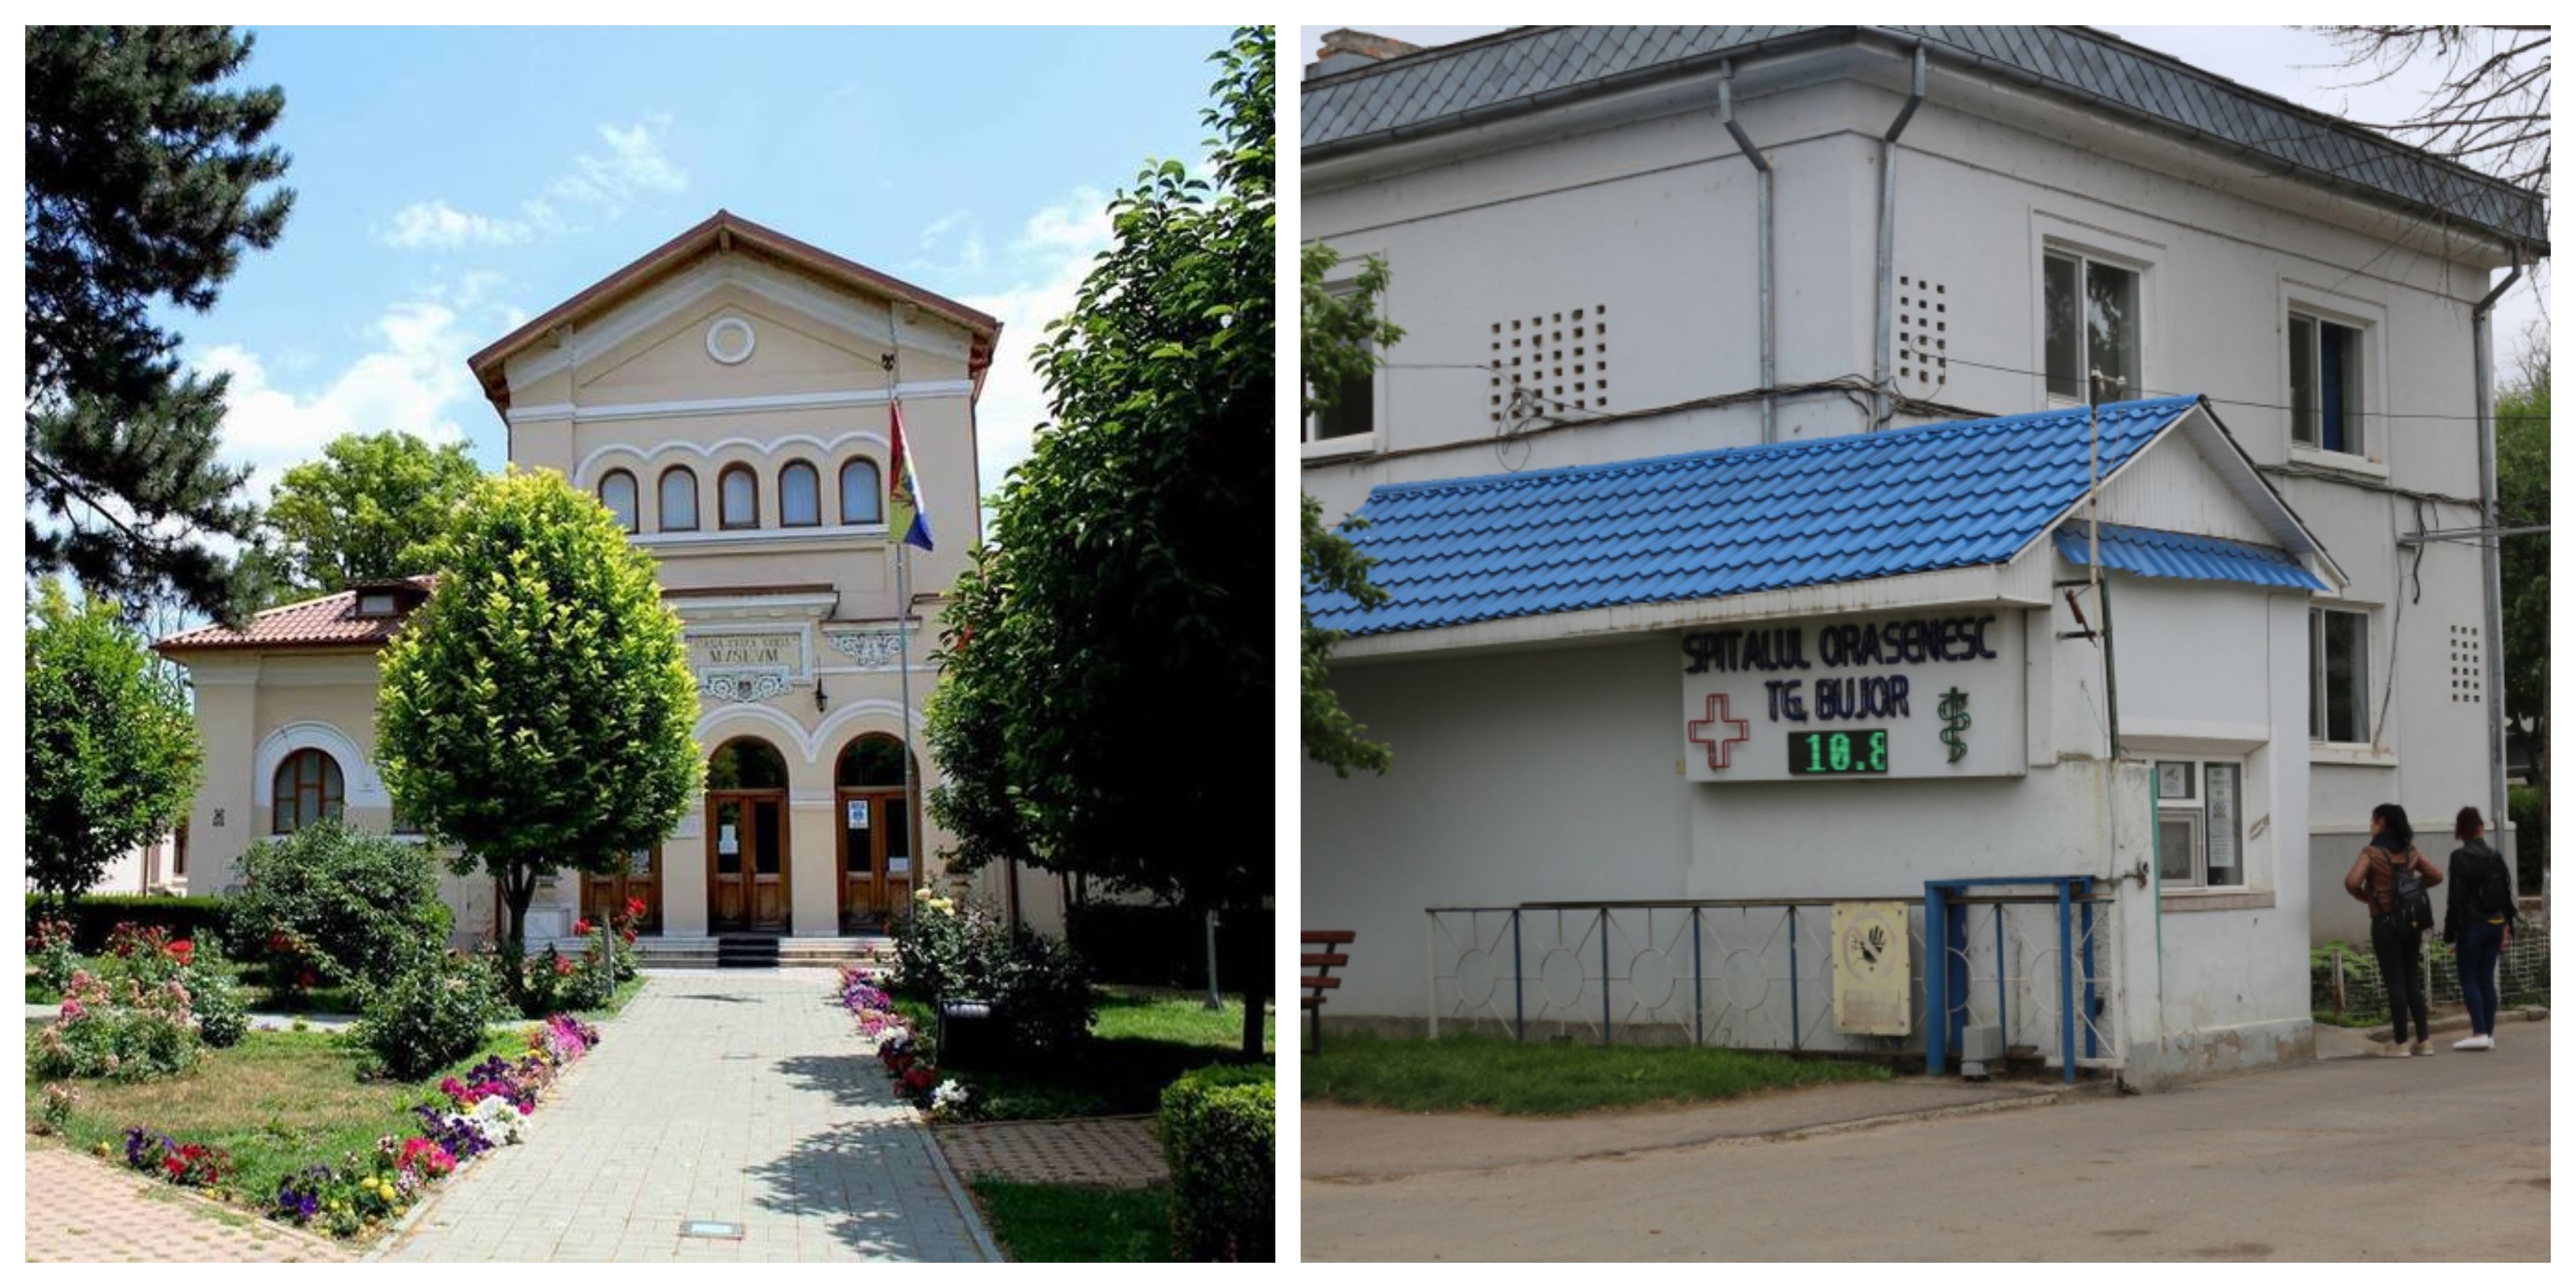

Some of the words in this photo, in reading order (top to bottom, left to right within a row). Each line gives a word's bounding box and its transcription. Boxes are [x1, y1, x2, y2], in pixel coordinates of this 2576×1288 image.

[1682, 627, 1811, 675] SPITALUL
[1819, 615, 1998, 668] ORASENESC
[1815, 674, 1911, 721] BUJOR
